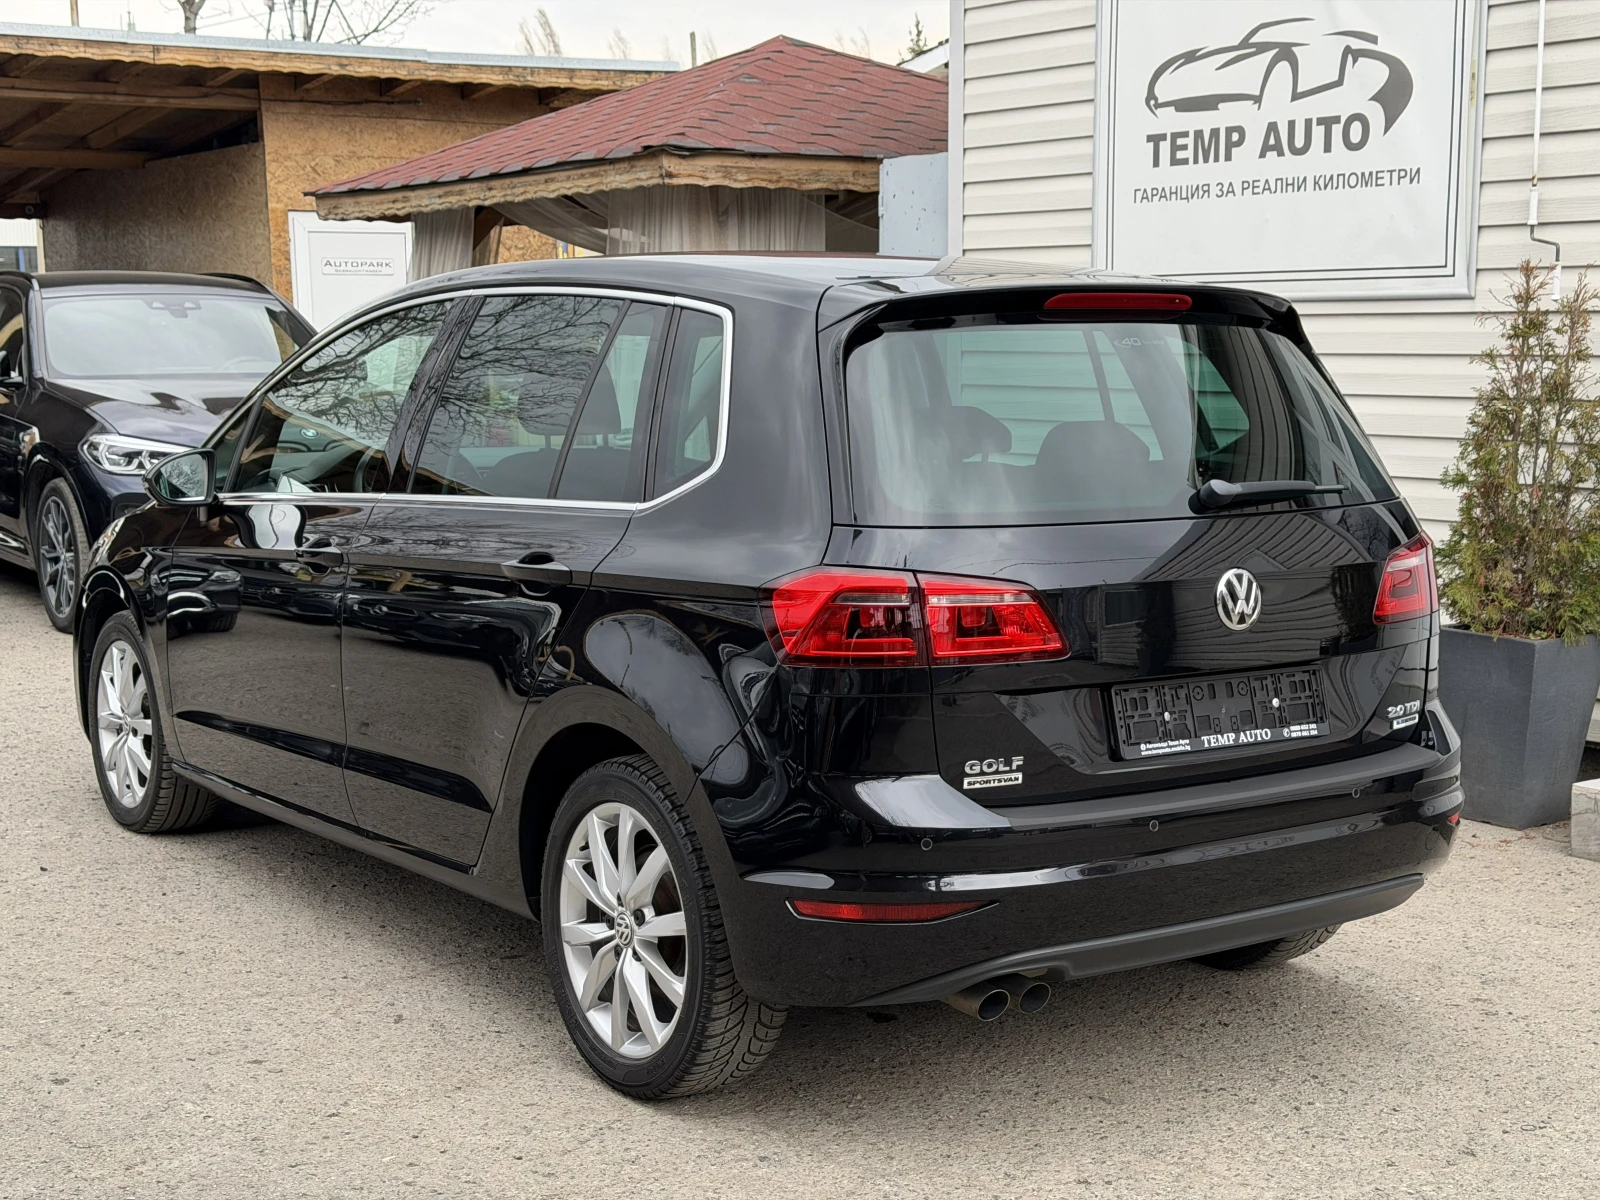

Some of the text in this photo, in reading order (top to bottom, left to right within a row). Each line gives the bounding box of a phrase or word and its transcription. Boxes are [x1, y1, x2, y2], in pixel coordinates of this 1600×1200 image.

[1146, 112, 1371, 168] TEMP AUTO
[1133, 167, 1421, 204] ГАРАНЦИЯ ЗА РЕАЛНИ КИЛОМЕТРИ
[323, 260, 392, 268] AUTOPARK
[1404, 699, 1420, 714] TDI
[1201, 728, 1271, 748] TEMP AUTO
[964, 756, 1024, 774] GOLF
[966, 776, 1020, 786] SPORTSVAN
